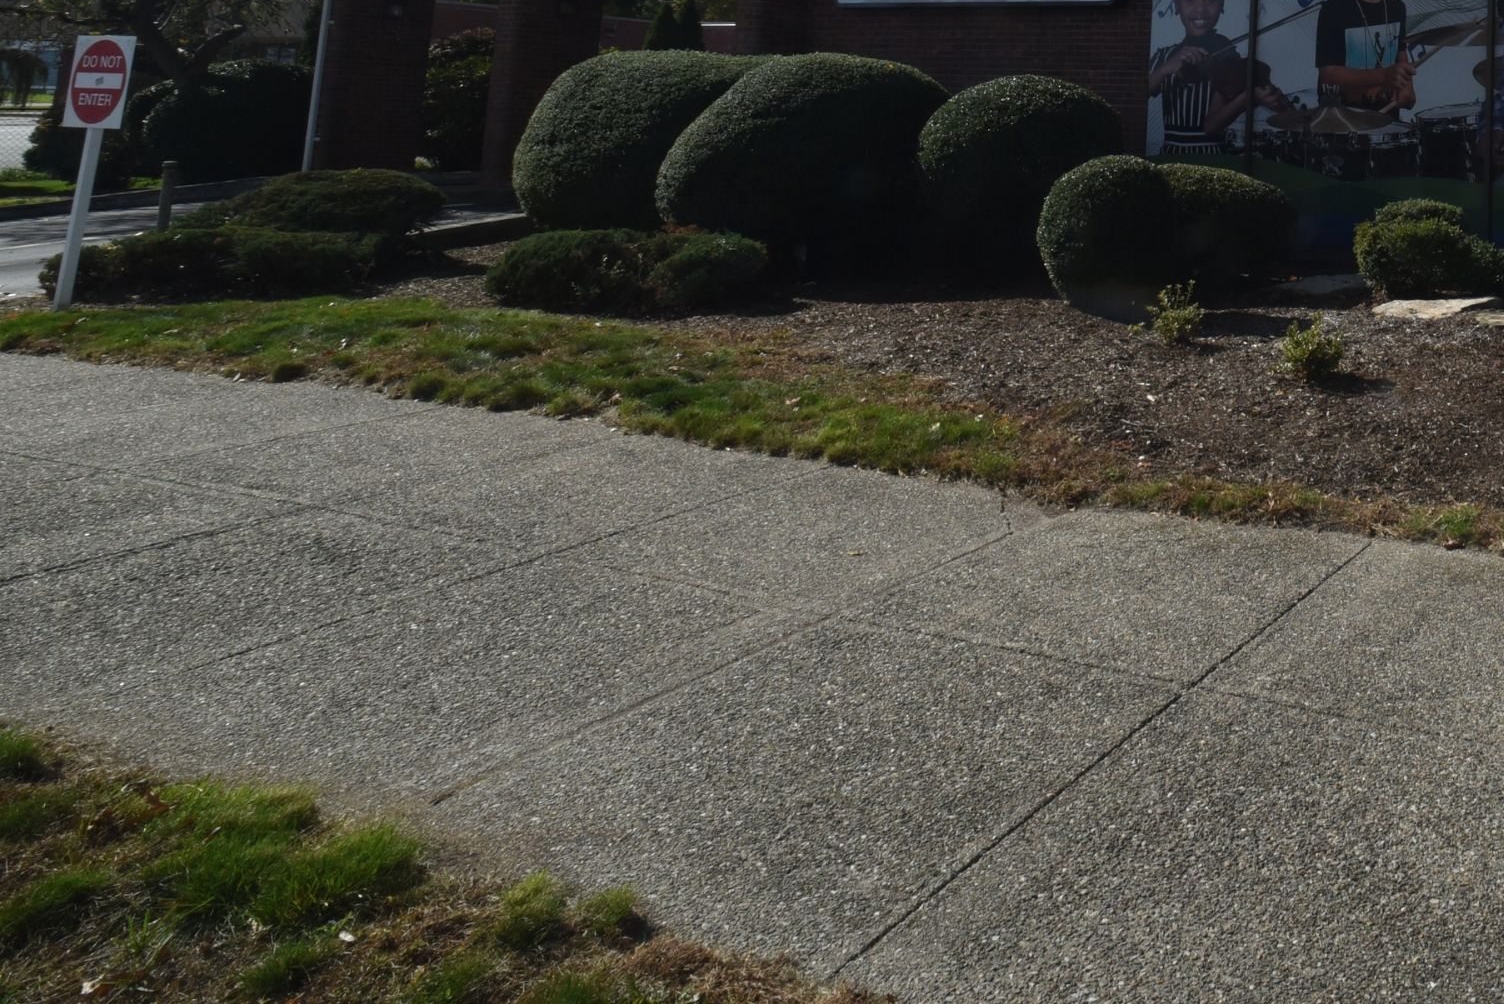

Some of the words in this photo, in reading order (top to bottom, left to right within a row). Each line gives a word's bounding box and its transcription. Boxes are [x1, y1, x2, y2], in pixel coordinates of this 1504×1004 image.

[82, 55, 98, 68] DO
[100, 56, 123, 68] NOT
[78, 93, 113, 106] ENTER
